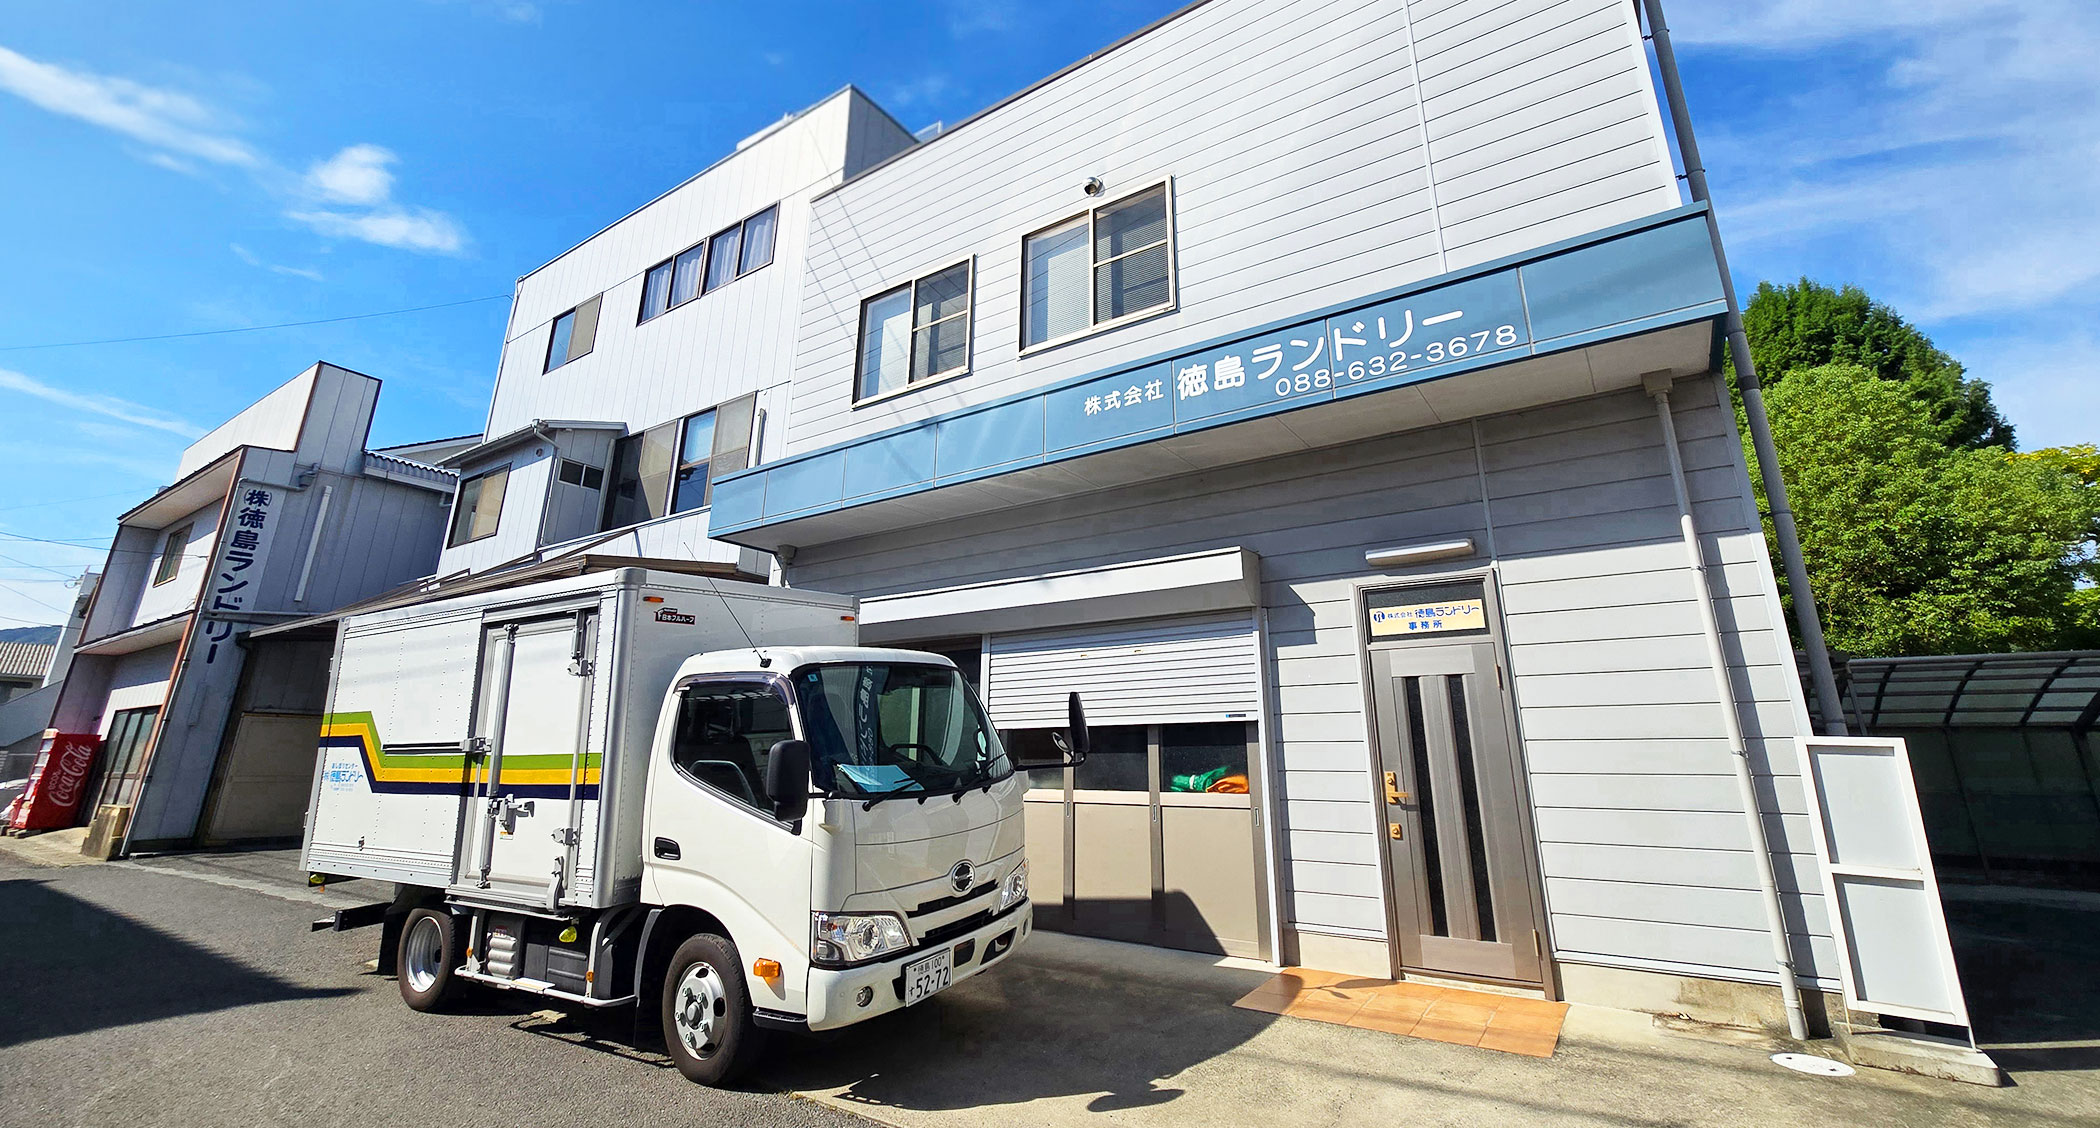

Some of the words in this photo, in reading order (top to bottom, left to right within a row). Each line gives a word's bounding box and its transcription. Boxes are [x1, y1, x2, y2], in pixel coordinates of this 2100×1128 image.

[1084, 378, 1164, 416] 株式会社
[1176, 309, 1464, 400] 徳島ランドリー
[1275, 324, 1518, 397] 088-632-3678
[1408, 620, 1443, 630] 事務所
[1414, 604, 1480, 619] 徳島ランドリー
[48, 741, 92, 807] Coca-Cola
[932, 956, 942, 970] 100
[916, 966, 949, 998] 52-72
